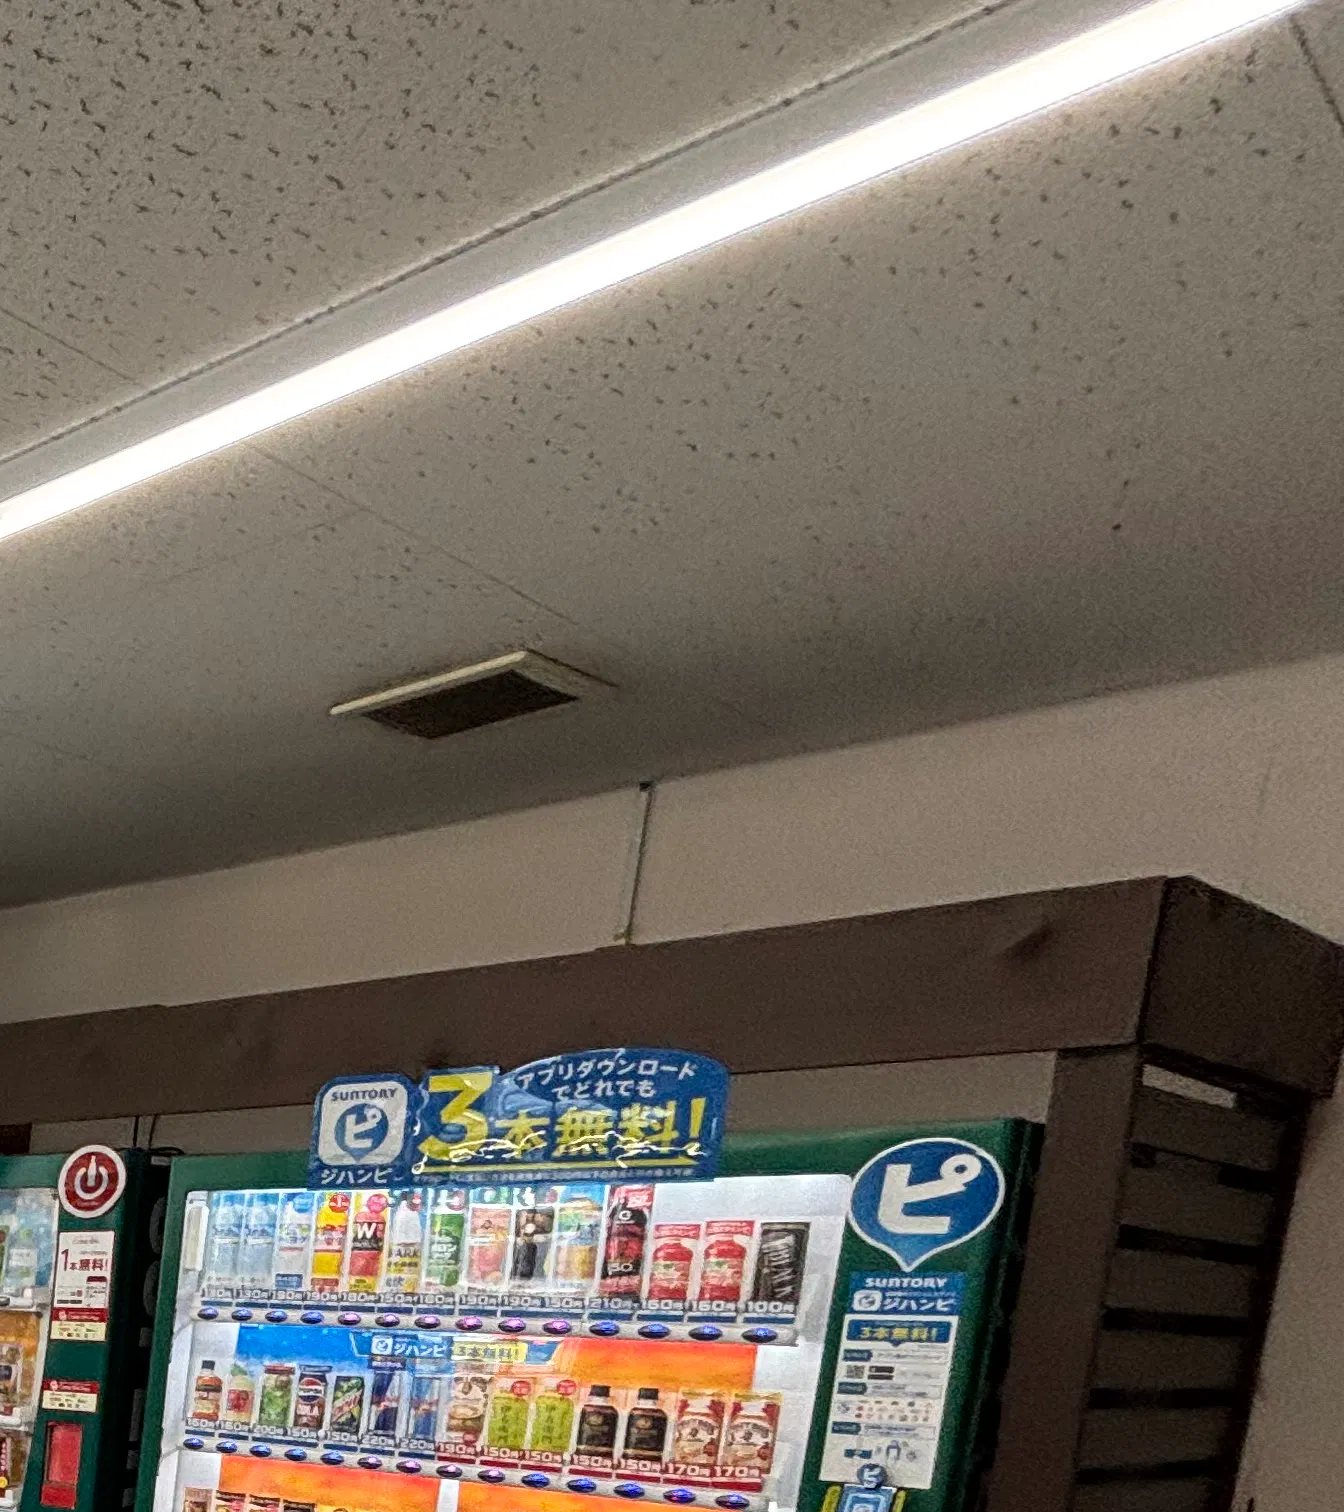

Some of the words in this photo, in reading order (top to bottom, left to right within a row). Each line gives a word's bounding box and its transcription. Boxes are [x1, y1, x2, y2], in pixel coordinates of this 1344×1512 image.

[516, 1058, 699, 1090] アプリダウンロード
[330, 1087, 399, 1102] SUNTORY
[418, 1072, 707, 1163] 3本無料!
[320, 1167, 395, 1185] ジハンピ
